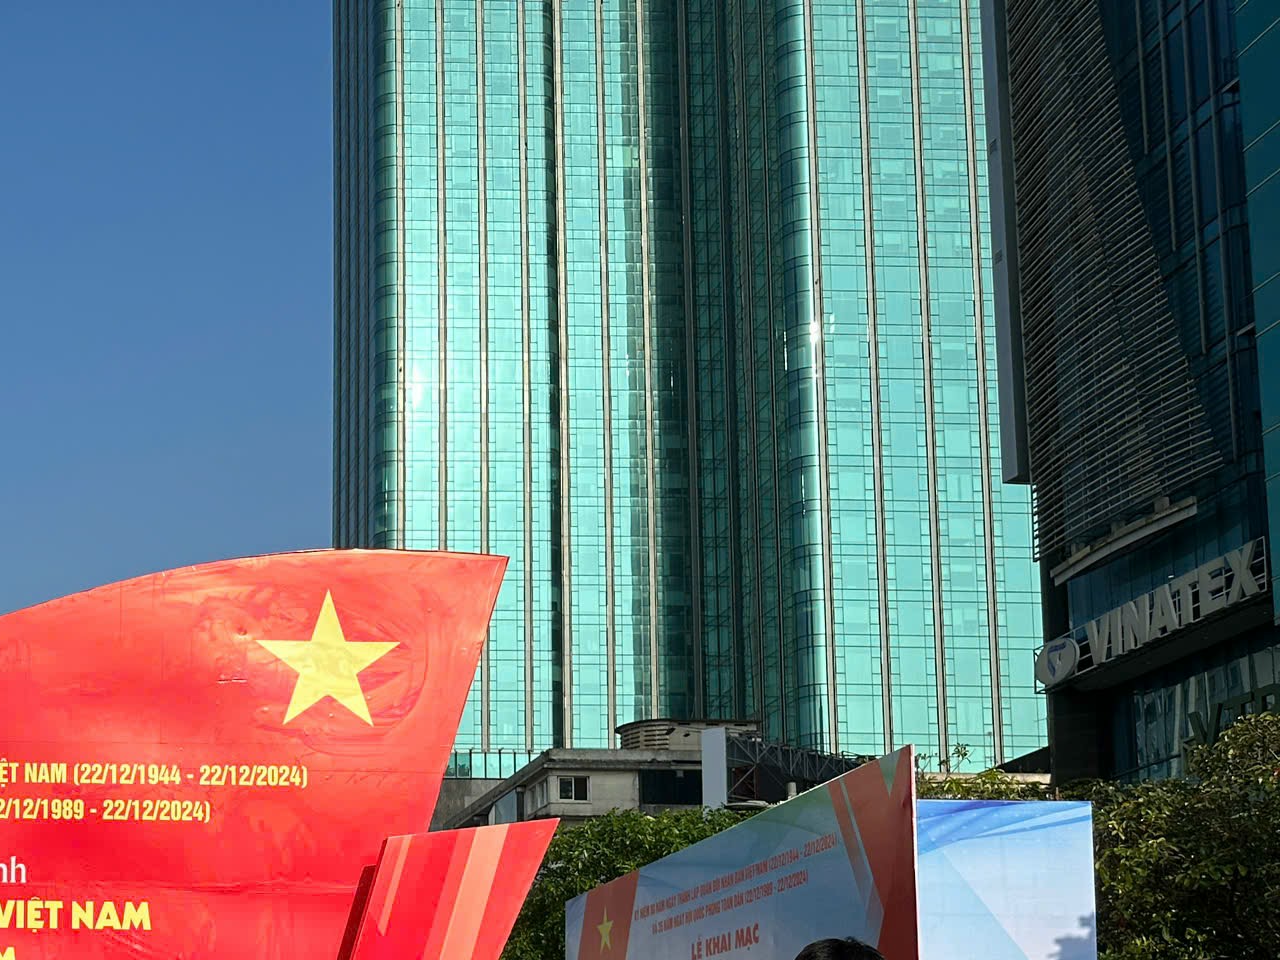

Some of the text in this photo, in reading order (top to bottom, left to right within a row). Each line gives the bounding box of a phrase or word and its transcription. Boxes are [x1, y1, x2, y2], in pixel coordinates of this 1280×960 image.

[1085, 540, 1261, 665] VINATEX
[24, 762, 68, 784] NAM
[73, 762, 182, 787] (22/12/1944
[199, 764, 308, 789] 22/12/2024)
[102, 799, 211, 824] 22/12/2024)
[71, 901, 152, 931] NAM
[705, 931, 731, 956] KHAI
[734, 923, 760, 951] MẠC
